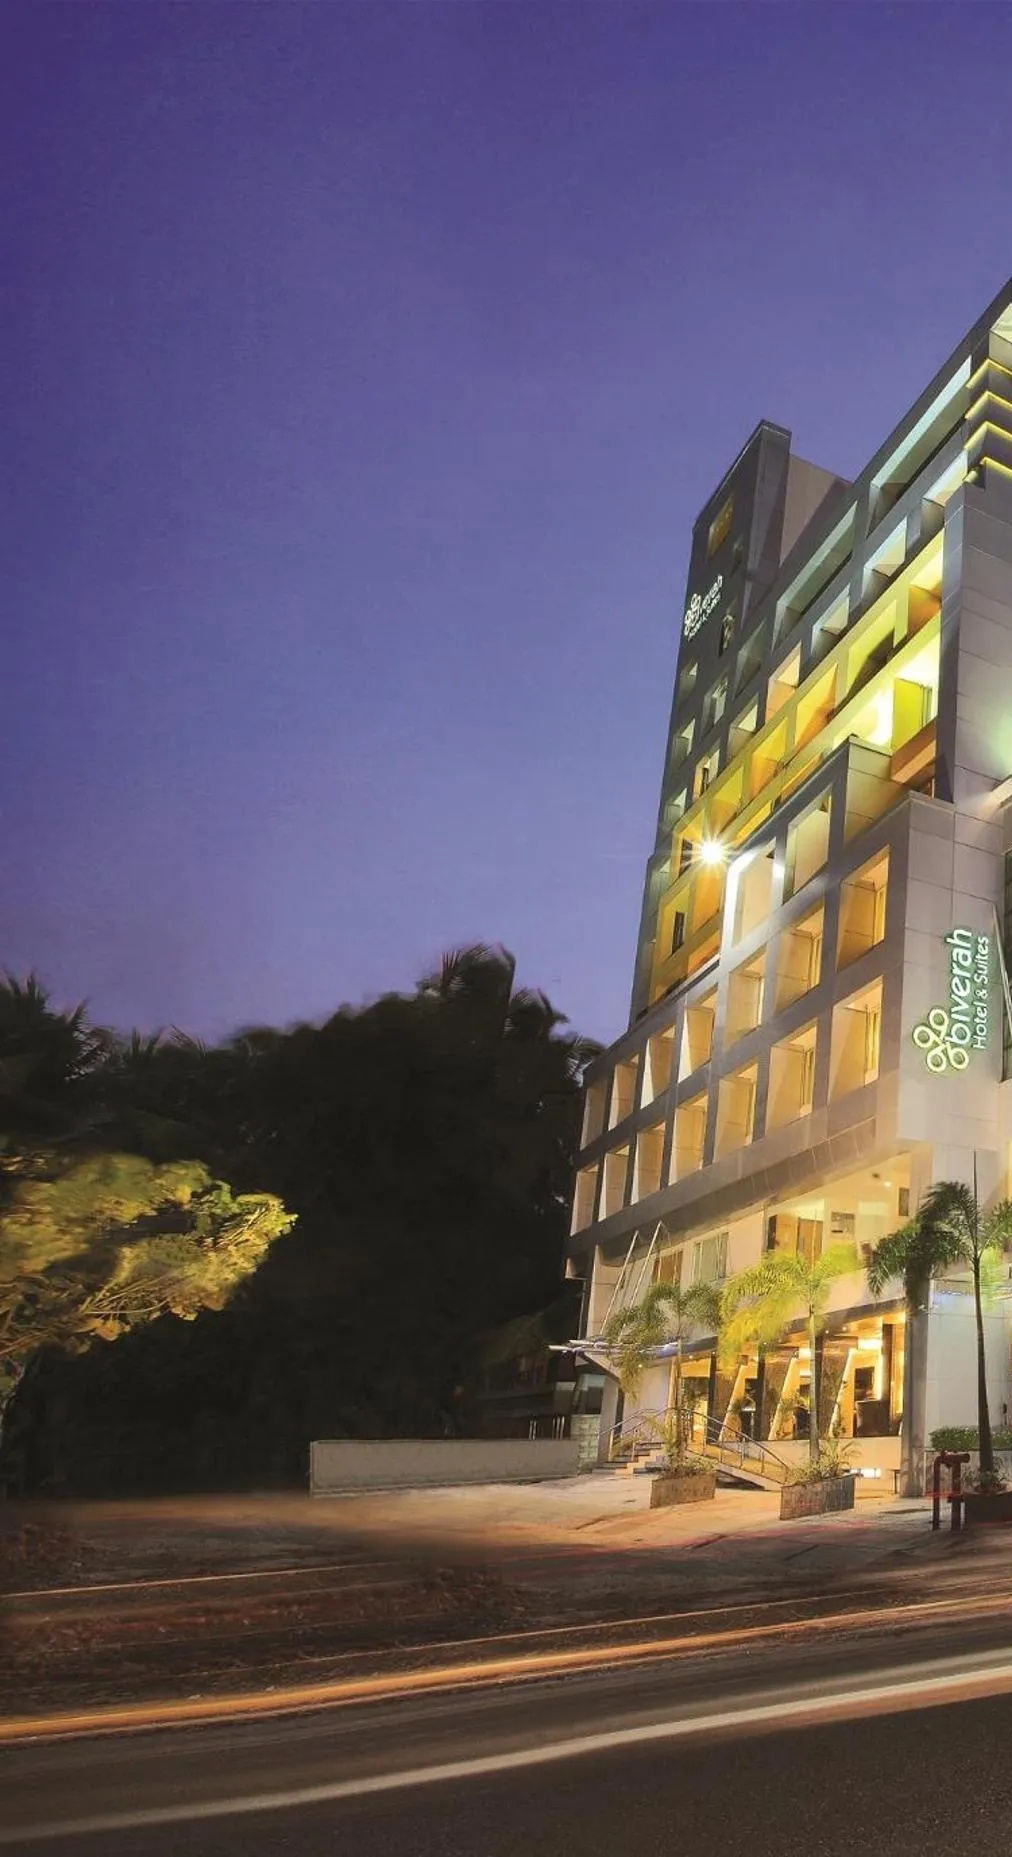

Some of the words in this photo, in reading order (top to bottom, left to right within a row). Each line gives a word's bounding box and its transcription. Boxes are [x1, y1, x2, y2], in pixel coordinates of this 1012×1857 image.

[973, 936, 989, 985] Suites
[945, 928, 972, 1045] biverah
[974, 989, 989, 998] &
[973, 1001, 988, 1050] Hotel
